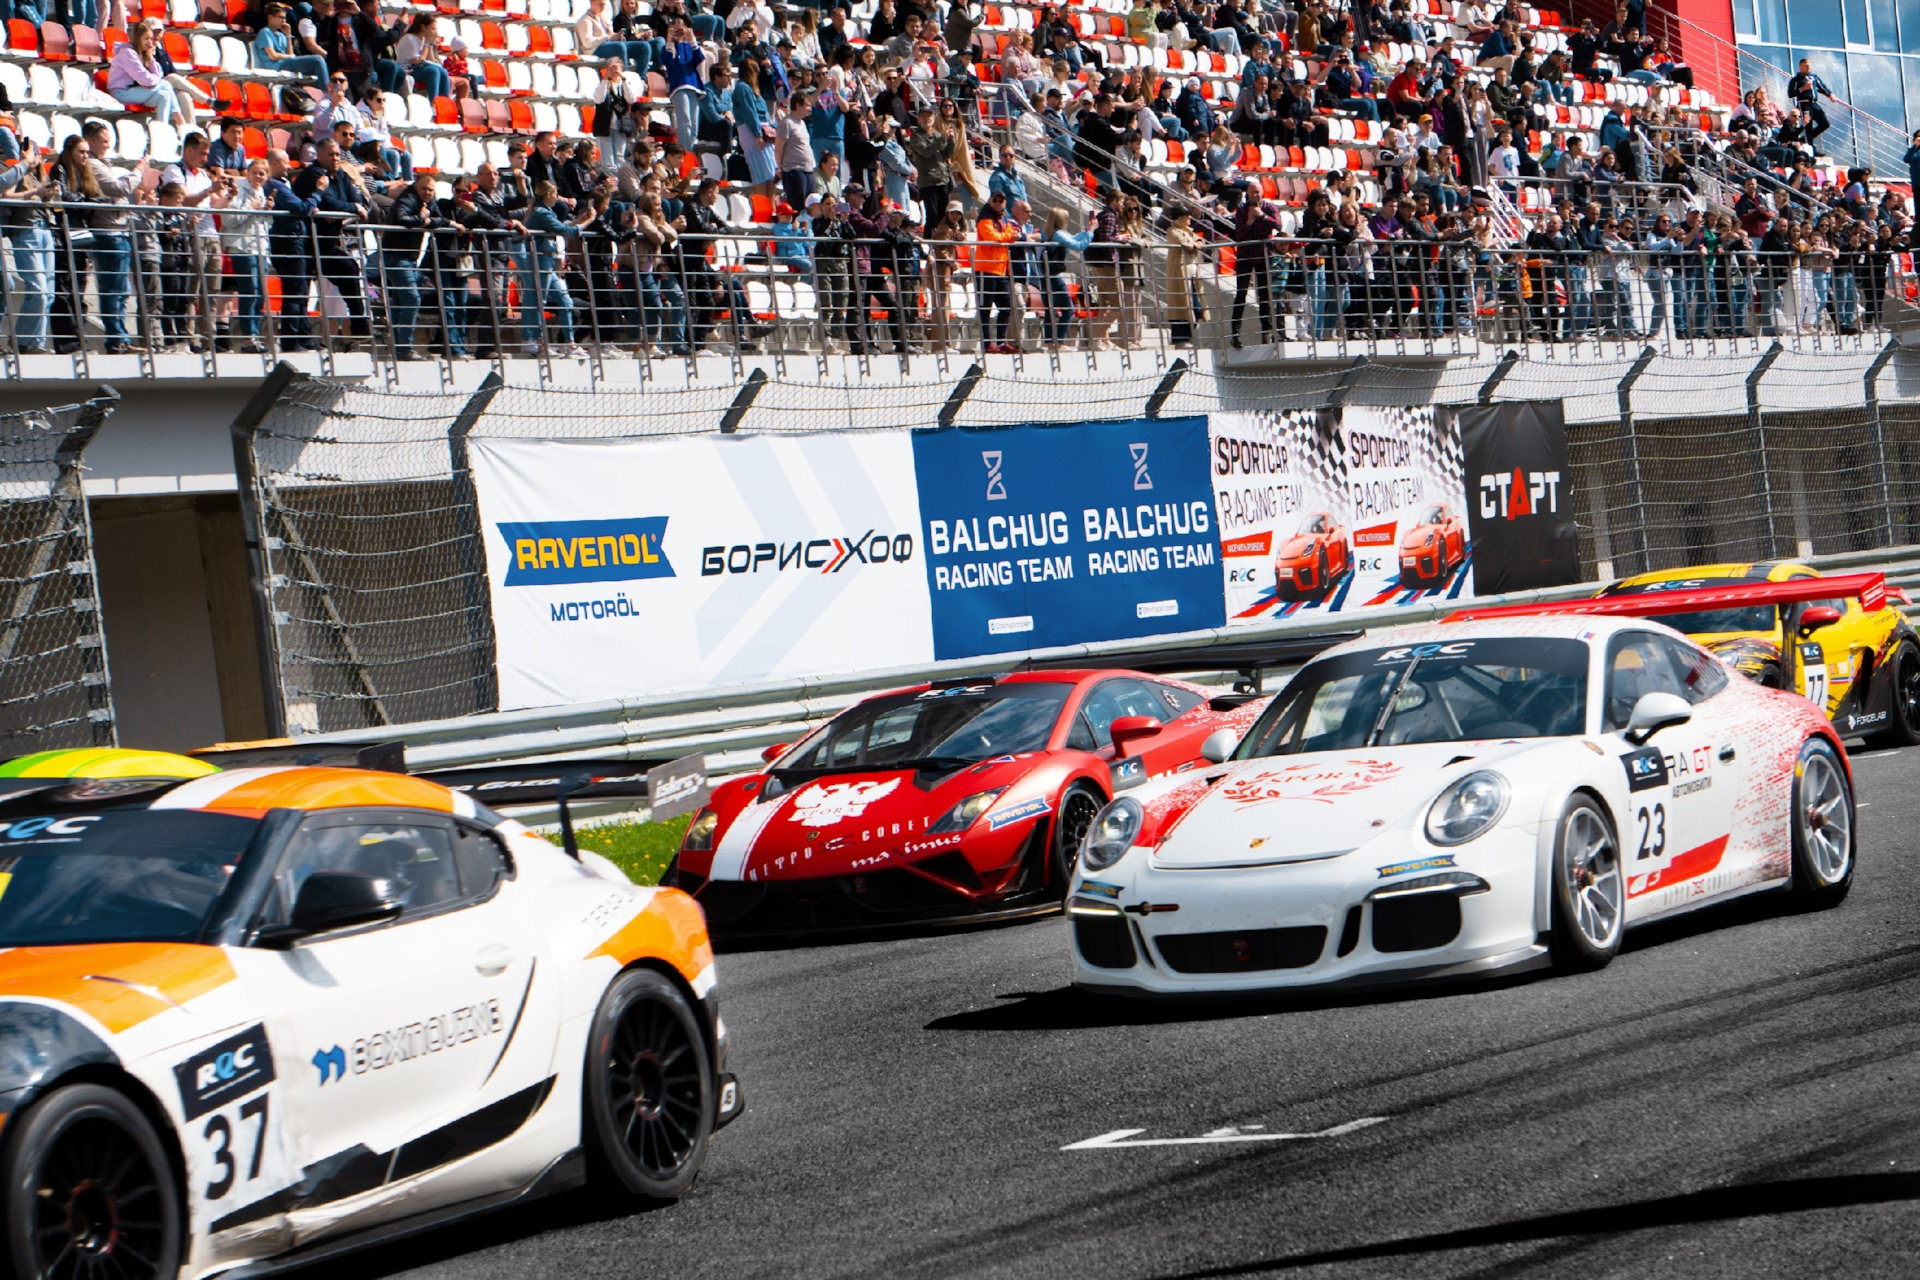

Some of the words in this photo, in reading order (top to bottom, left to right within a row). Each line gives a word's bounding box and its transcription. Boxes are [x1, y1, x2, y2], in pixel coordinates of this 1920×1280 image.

[1214, 435, 1289, 476] SPORTCAR
[1348, 430, 1411, 468] SPORTCAR
[1219, 486, 1277, 529] RACING
[1277, 484, 1303, 515] TEAM
[1353, 479, 1400, 520] RACING
[1400, 477, 1424, 506] TEAM
[1480, 467, 1560, 521] СТАРТ
[929, 511, 1069, 554] BALCHUG
[1083, 501, 1209, 542] BALCHUG
[516, 534, 659, 570] RAVENOL
[1088, 547, 1160, 576] RACING
[1162, 543, 1215, 569] TEAM
[935, 561, 1014, 591] RACING
[1017, 556, 1074, 583] TEAM
[551, 593, 640, 622] MOTORÖL
[1809, 674, 1825, 705] 77
[1693, 746, 1712, 773] GT
[993, 802, 1043, 823] RAVENOL
[1637, 802, 1666, 861] 23
[1381, 857, 1452, 875] RAVENOL
[203, 1091, 269, 1201] 37
